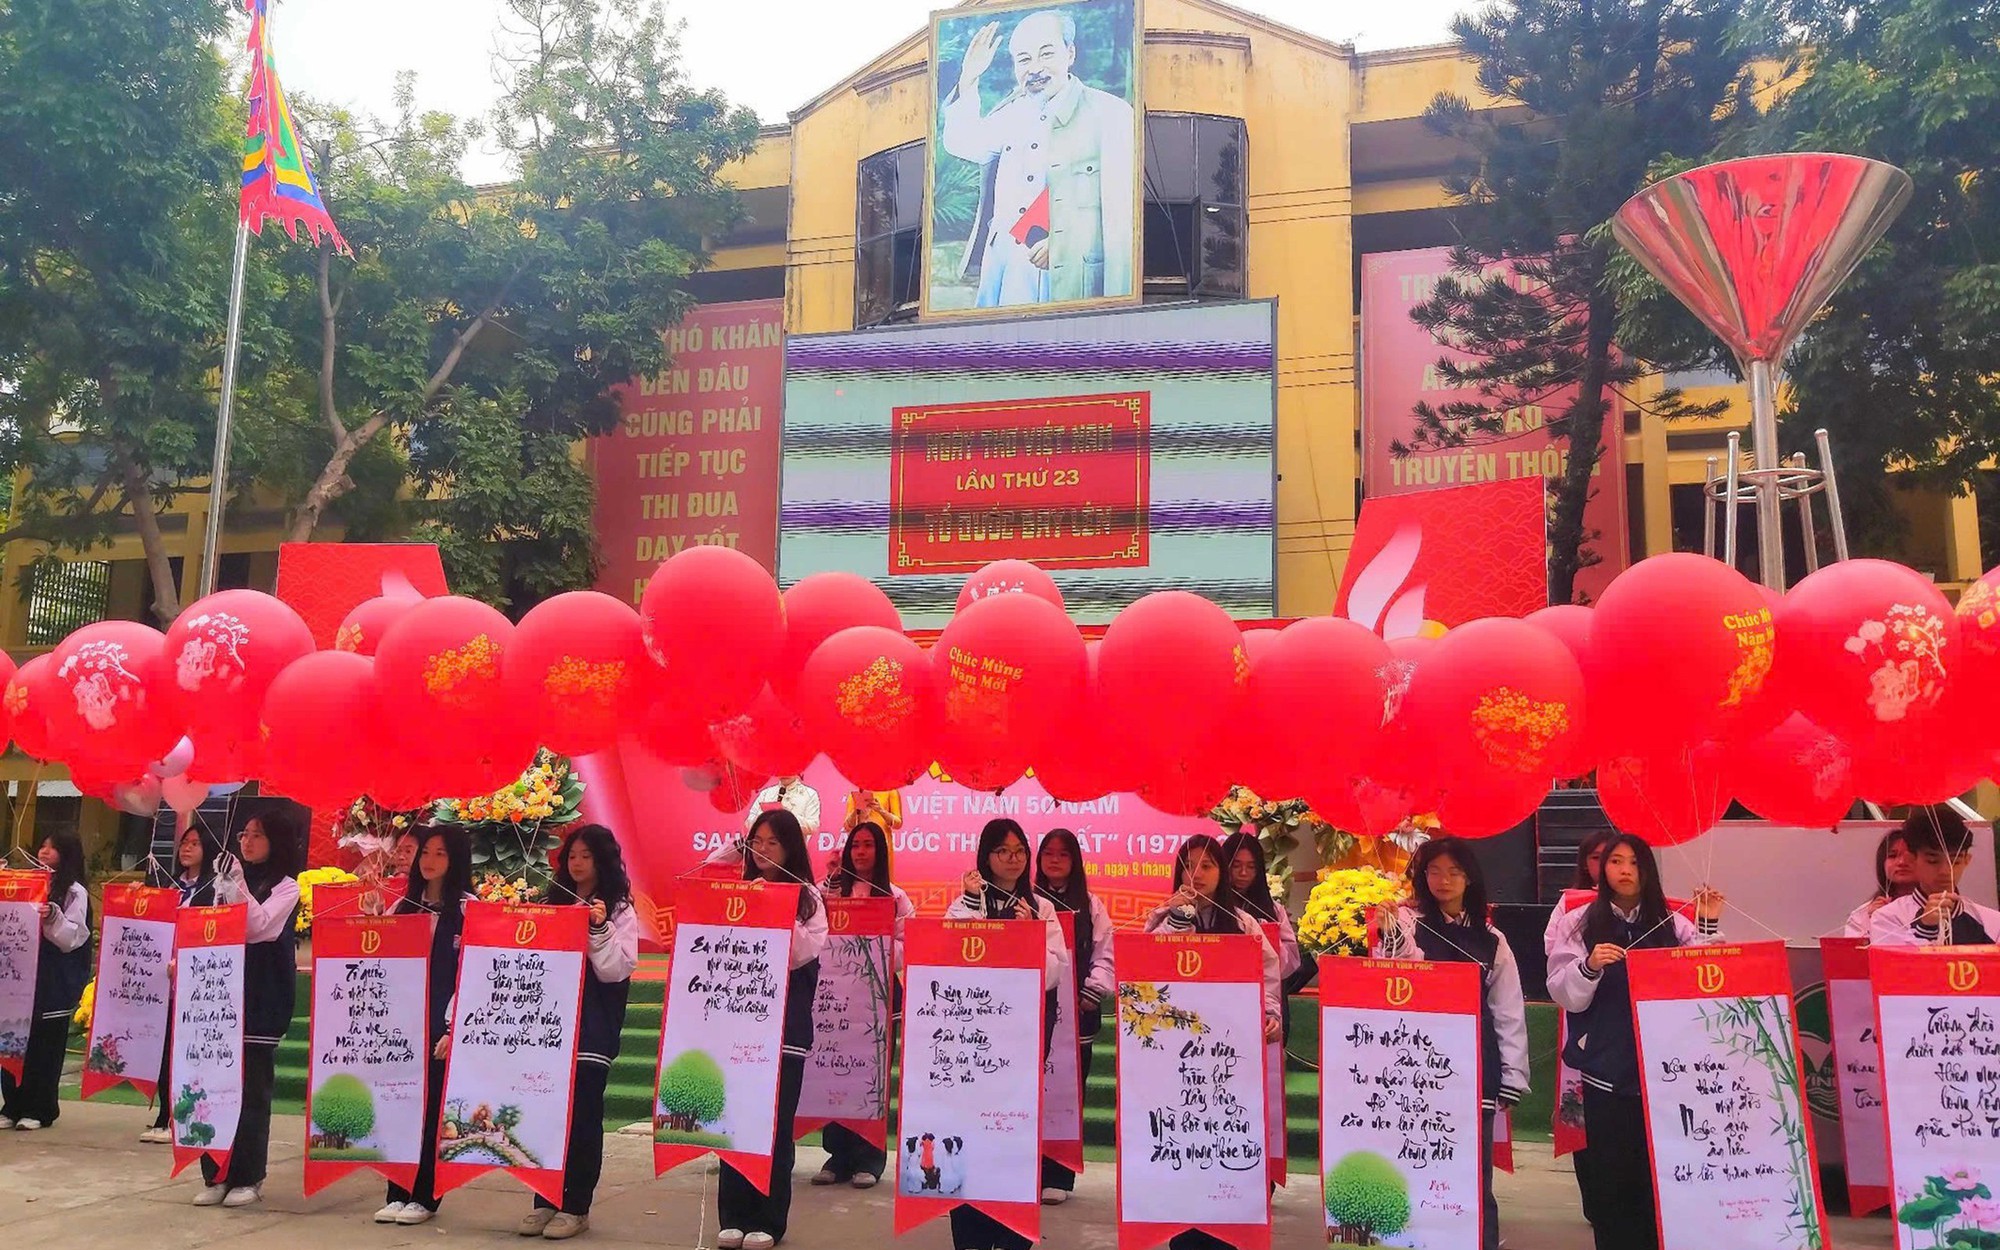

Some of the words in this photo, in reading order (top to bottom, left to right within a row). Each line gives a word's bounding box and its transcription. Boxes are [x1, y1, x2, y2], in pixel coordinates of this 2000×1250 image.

[712, 318, 780, 350] KHĂN
[698, 362, 749, 393] ĐÂU
[625, 408, 693, 438] CŨNG
[702, 397, 762, 433] PHẢI
[636, 444, 690, 478] TIẾP
[699, 449, 746, 480] TỤC
[956, 468, 996, 491] LẦN
[1002, 466, 1049, 489] THỨ
[1053, 469, 1079, 486] 23
[640, 493, 679, 520] THI
[687, 491, 738, 517] ĐUA
[1723, 609, 1760, 630] Chúc
[949, 645, 979, 668] Chúc
[980, 656, 1024, 681] Mừng
[950, 664, 978, 687] Năm
[980, 673, 1007, 693] Mới
[906, 790, 957, 820] VIỆT
[964, 796, 1019, 815] NAM
[1132, 861, 1139, 876] 9
